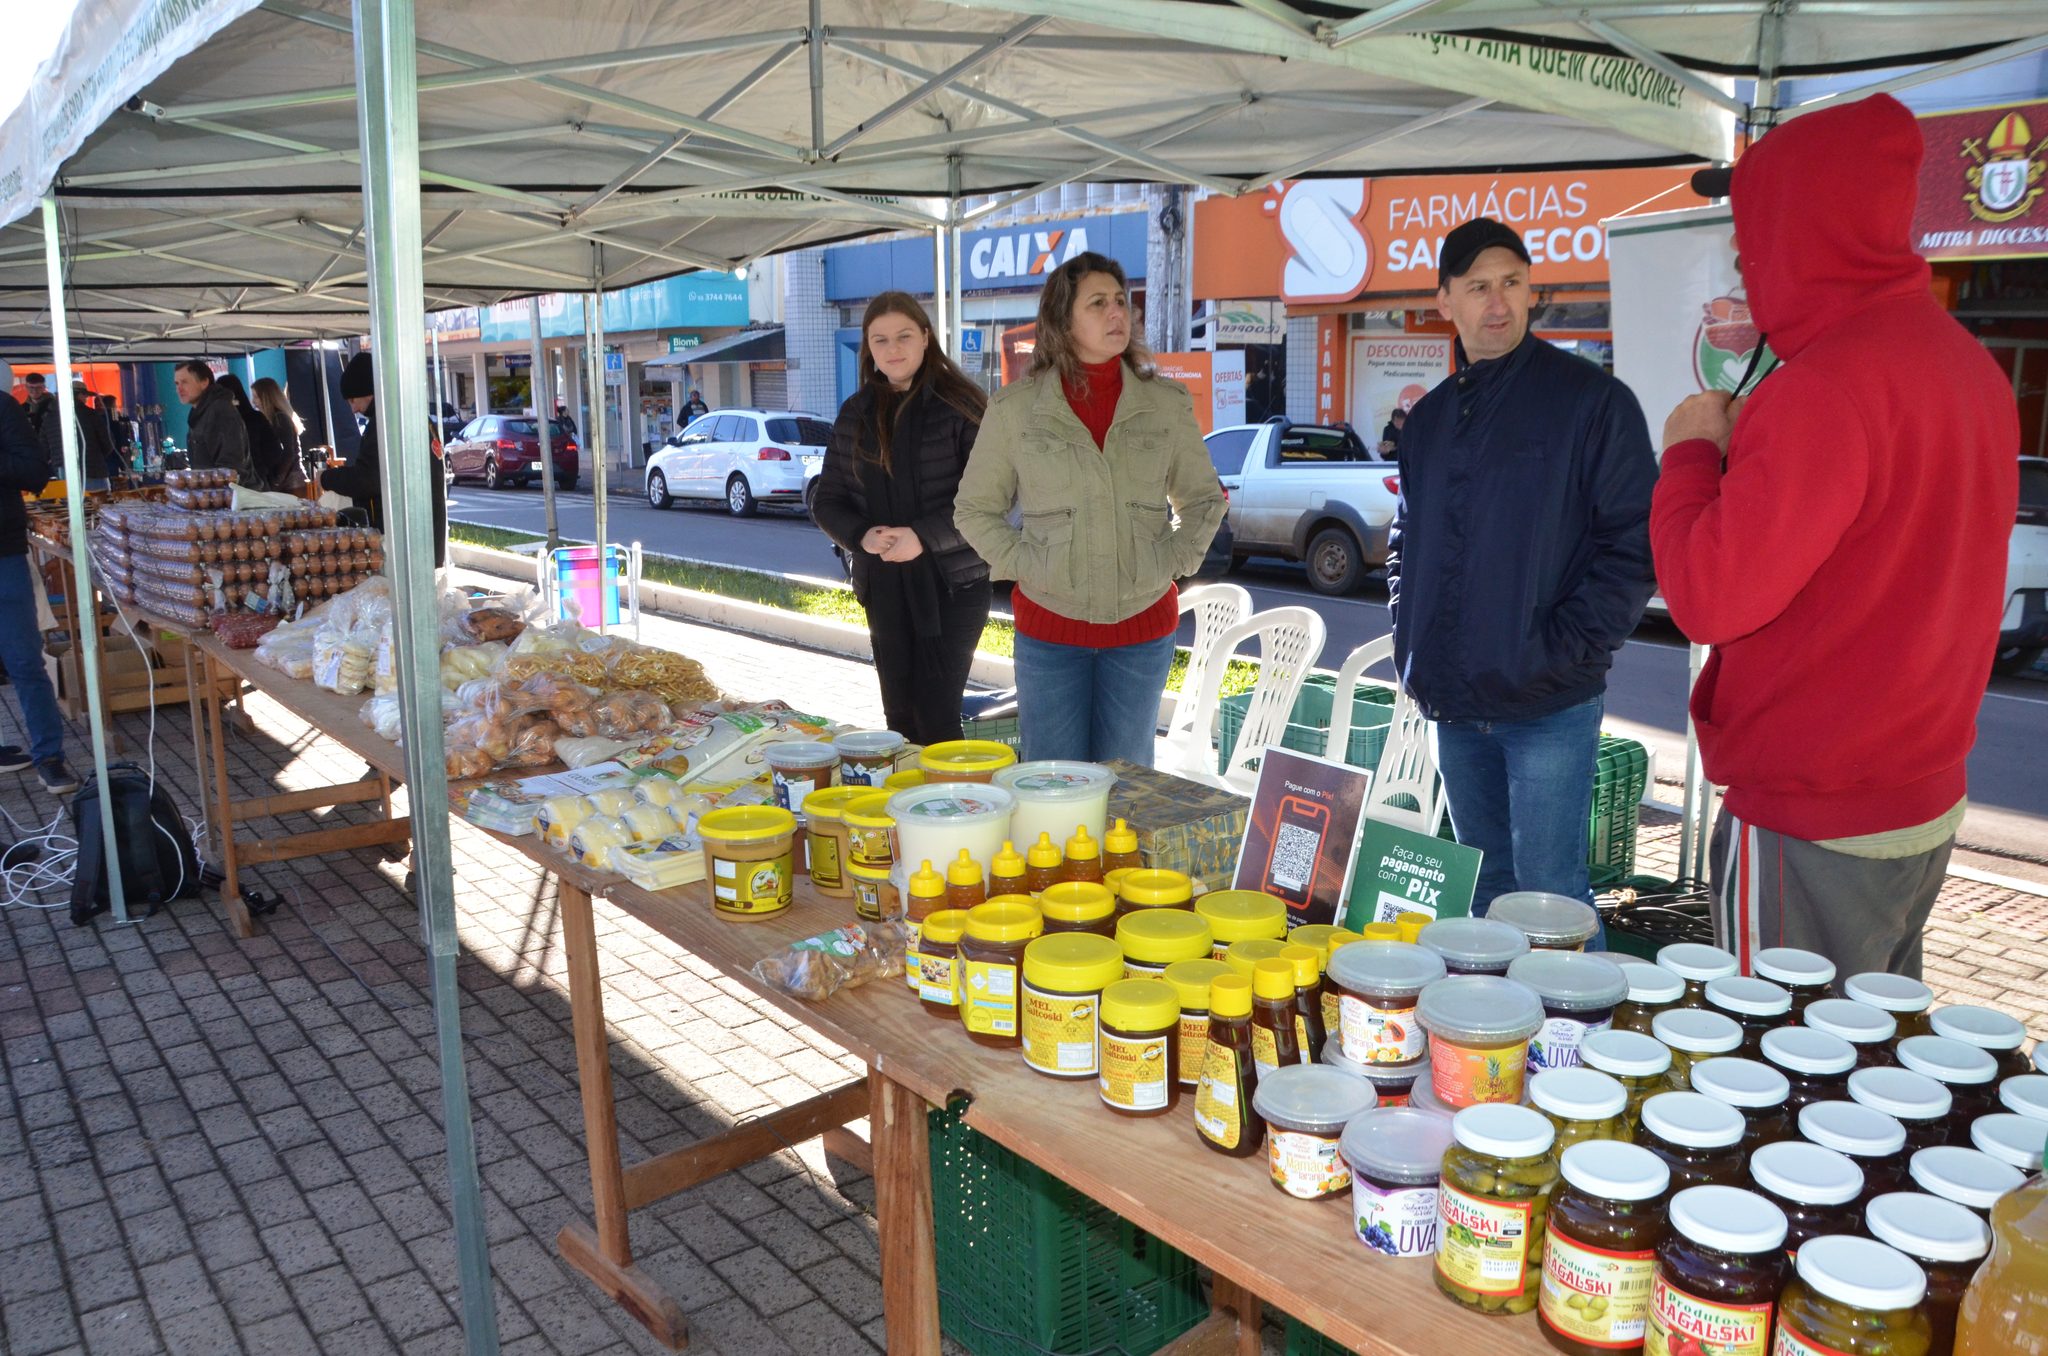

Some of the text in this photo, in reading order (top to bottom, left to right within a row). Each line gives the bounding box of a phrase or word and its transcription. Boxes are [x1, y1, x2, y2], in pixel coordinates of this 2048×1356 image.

[1590, 56, 1685, 110] CONSOME!
[1388, 179, 1589, 232] FARMÁCIAS
[1919, 230, 1974, 249] MITRA
[969, 227, 1089, 280] CAIXA
[705, 292, 724, 302] 3744
[725, 291, 743, 302] 7644
[1366, 344, 1445, 359] DESCONTOS
[1214, 370, 1243, 383] OFERTAS
[1284, 779, 1303, 793] Pague
[1303, 786, 1316, 795] com
[1321, 790, 1335, 801] Pix!
[1392, 844, 1443, 869] Faça o seu
[1380, 854, 1446, 884] pagamento
[1378, 868, 1443, 907] com o Pix
[1029, 997, 1053, 1012] MEL
[1183, 1022, 1206, 1032] MEL
[1108, 1041, 1128, 1054] MEL
[1547, 1046, 1580, 1069] UVA
[1286, 1154, 1324, 1174] Mamão
[1399, 1222, 1437, 1254] UVA
[1652, 1274, 1756, 1342] MAGALSKI
